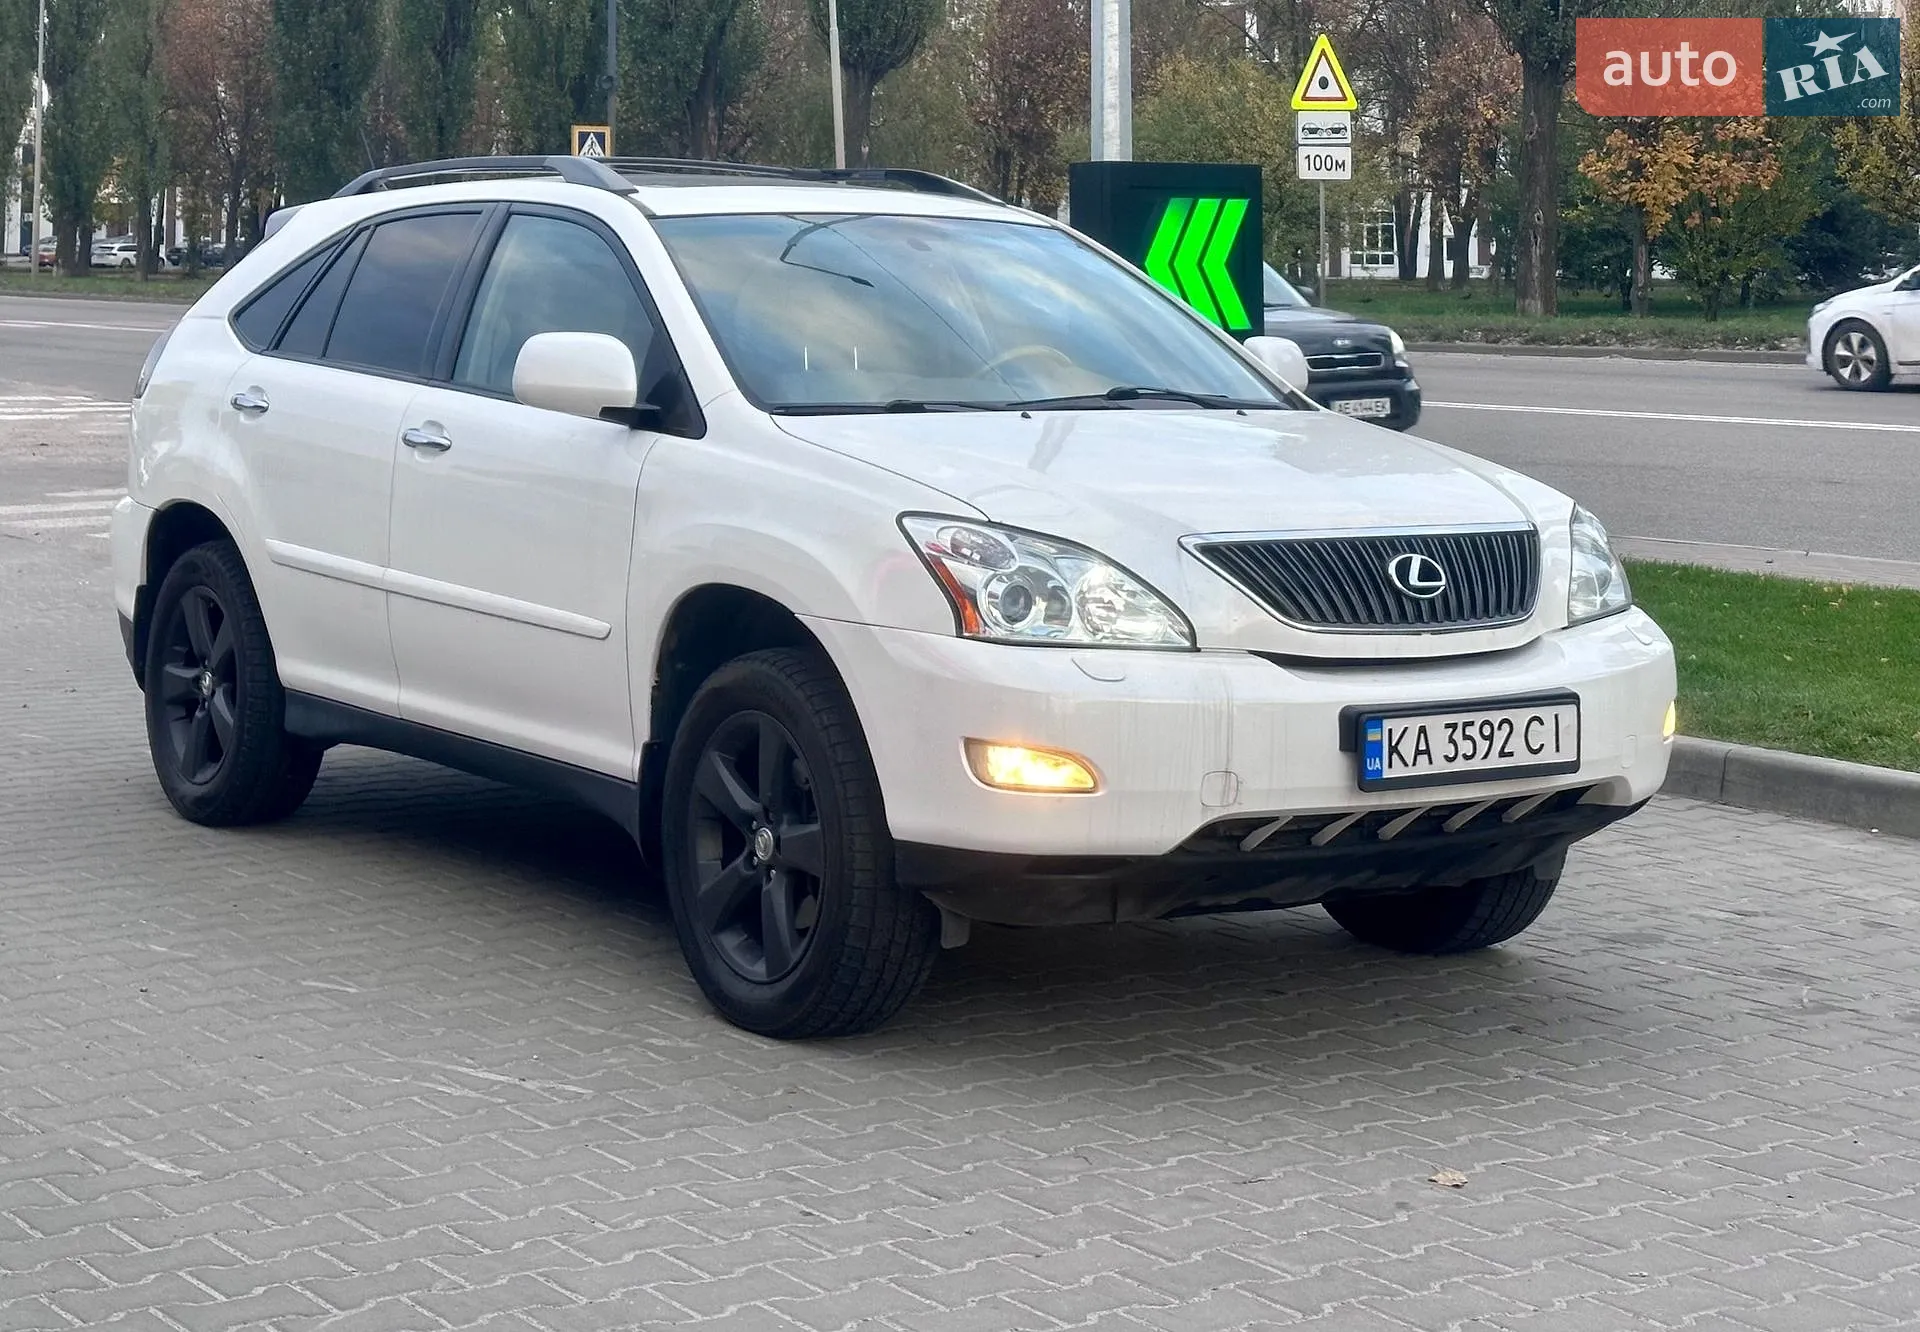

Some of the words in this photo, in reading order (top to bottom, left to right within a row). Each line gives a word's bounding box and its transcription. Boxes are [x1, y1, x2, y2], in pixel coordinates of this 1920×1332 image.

[1387, 724, 1434, 769] KA
[1442, 717, 1515, 764] 3592
[1523, 712, 1561, 756] CI
[1366, 757, 1382, 770] UA
